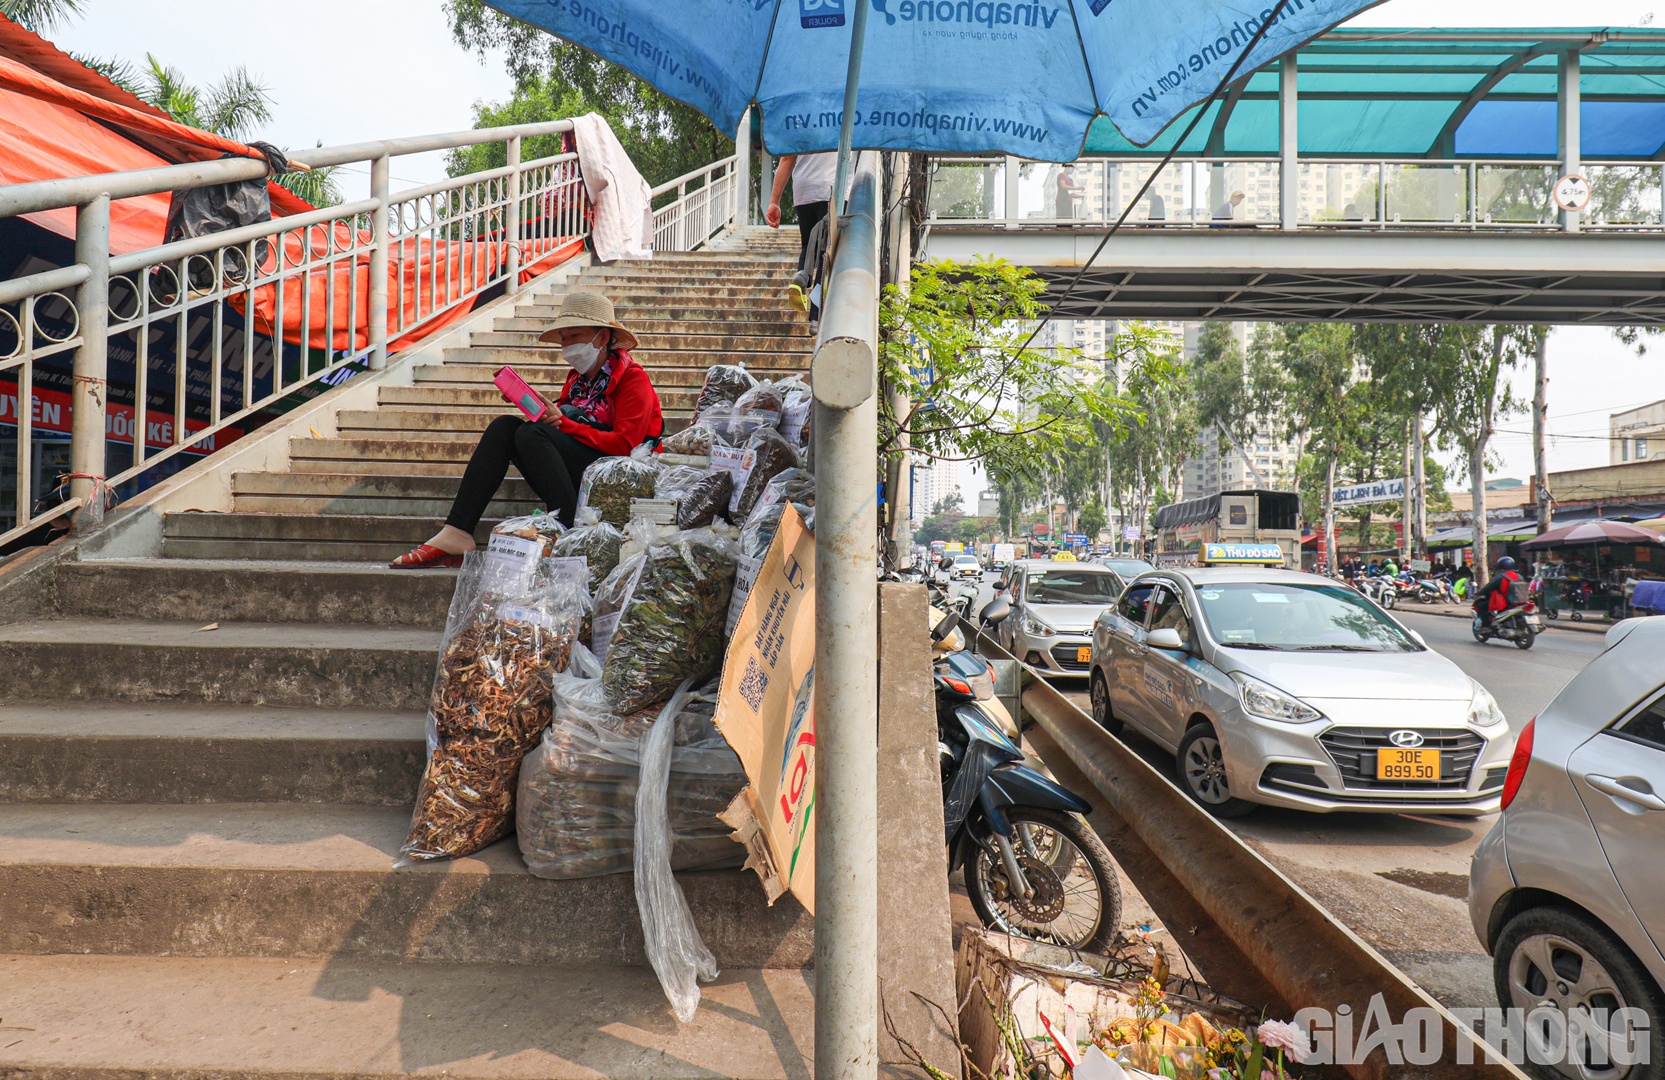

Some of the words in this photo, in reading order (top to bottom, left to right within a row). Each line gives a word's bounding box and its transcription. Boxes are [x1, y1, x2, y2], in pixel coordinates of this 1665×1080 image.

[148, 420, 173, 444] KÊ
[1226, 546, 1245, 558] THỦ
[1246, 547, 1262, 558] ĐÔ
[1262, 548, 1281, 558] SAO
[761, 609, 773, 633] HÀNG
[769, 588, 781, 611] NGAY
[1396, 750, 1423, 764] 30E
[1384, 764, 1434, 778] 899.50
